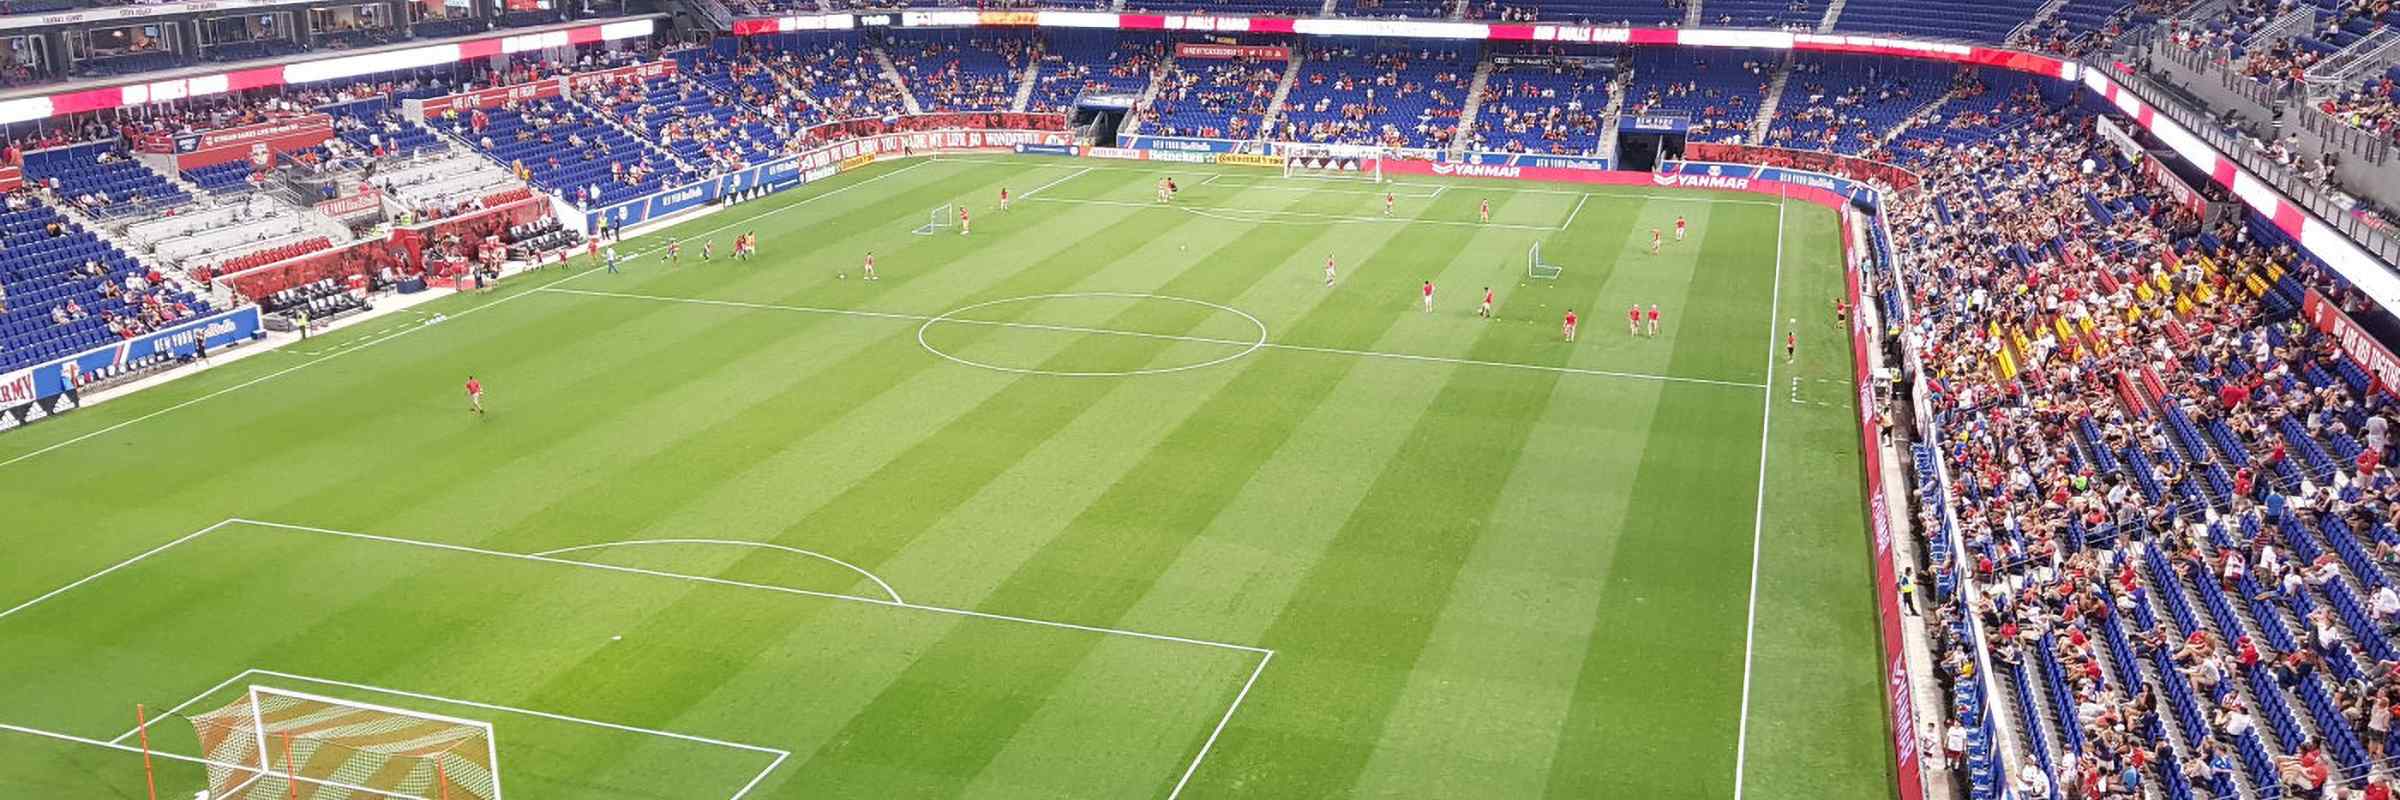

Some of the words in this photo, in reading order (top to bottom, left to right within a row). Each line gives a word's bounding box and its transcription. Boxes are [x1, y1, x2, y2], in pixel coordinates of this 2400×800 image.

[1149, 150, 1203, 163] Heineken
[1455, 164, 1521, 177] YANMAR
[1678, 174, 1750, 189] YANMAR
[0, 373, 34, 402] RMY
